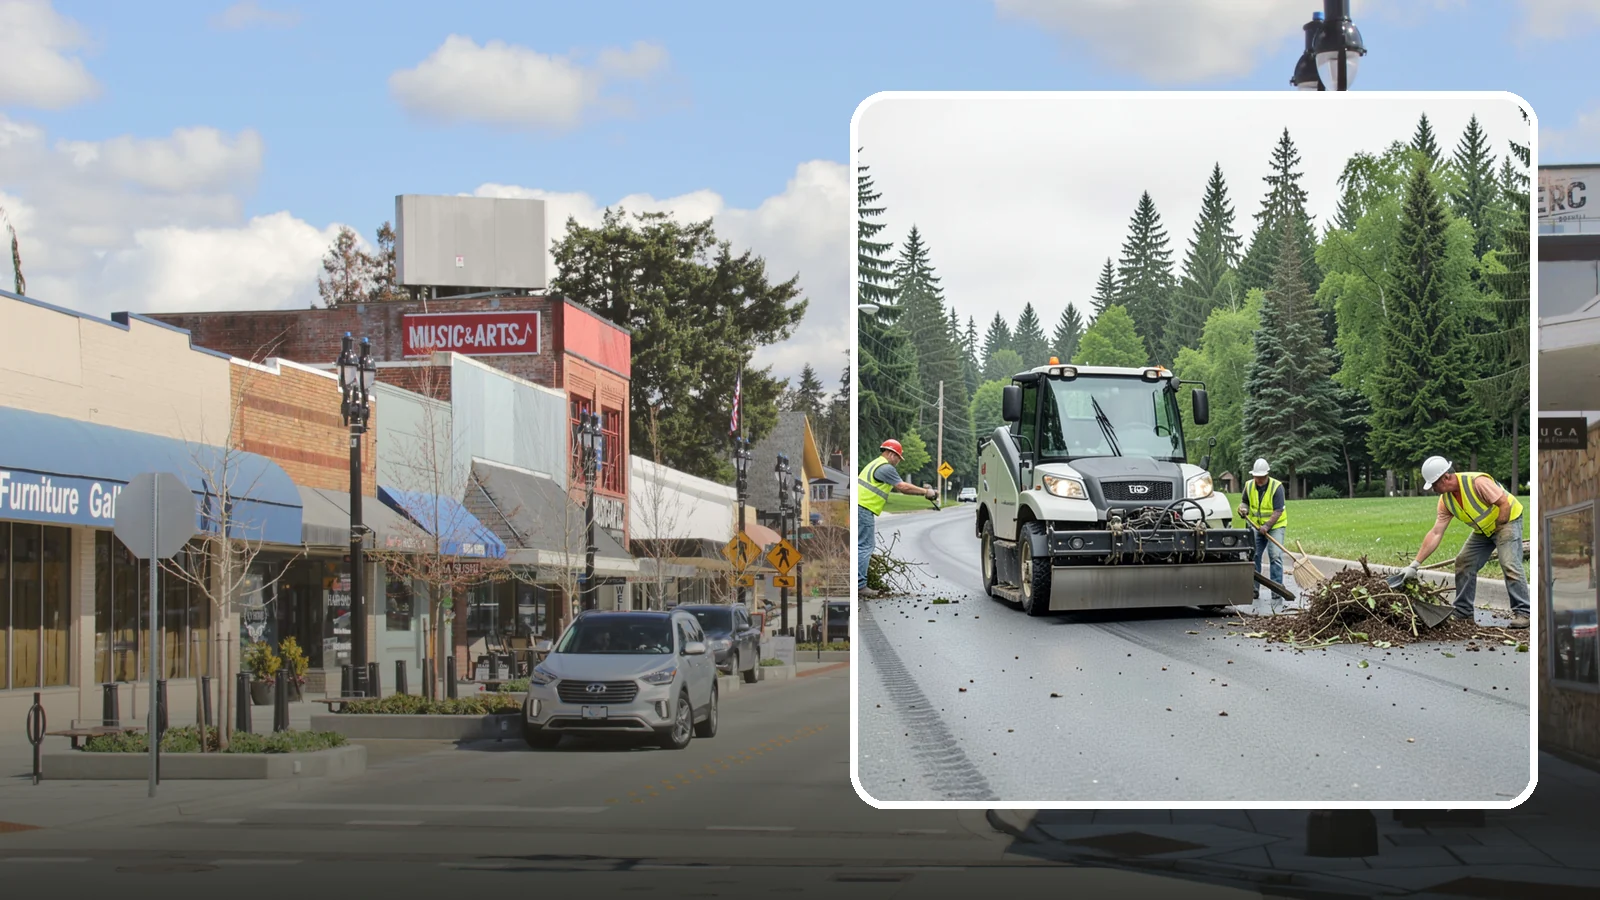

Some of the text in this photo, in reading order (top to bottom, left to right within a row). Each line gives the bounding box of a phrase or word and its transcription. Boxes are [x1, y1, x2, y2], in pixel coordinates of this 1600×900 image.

[408, 322, 520, 349] MUSIC&ARTS
[0, 471, 122, 519] Furniture Gal
[453, 563, 479, 575] SUSHI
